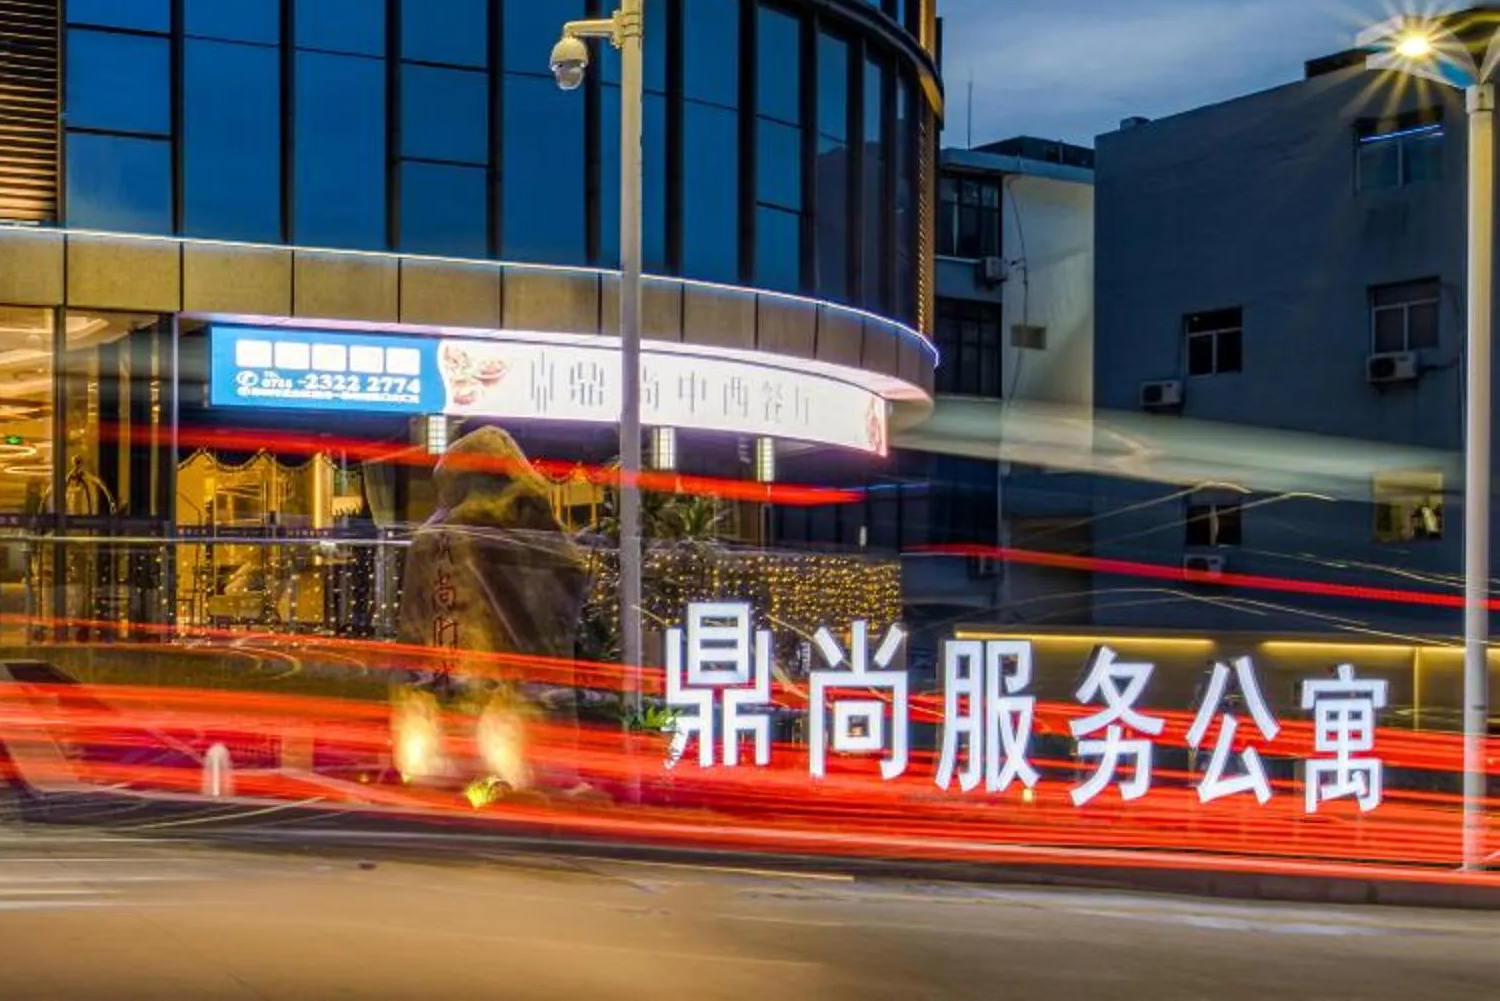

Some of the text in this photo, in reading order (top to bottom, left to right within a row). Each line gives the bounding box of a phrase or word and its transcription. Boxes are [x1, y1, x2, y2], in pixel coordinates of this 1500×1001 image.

[663, 601, 1387, 814] 鼎尚服务公寓
